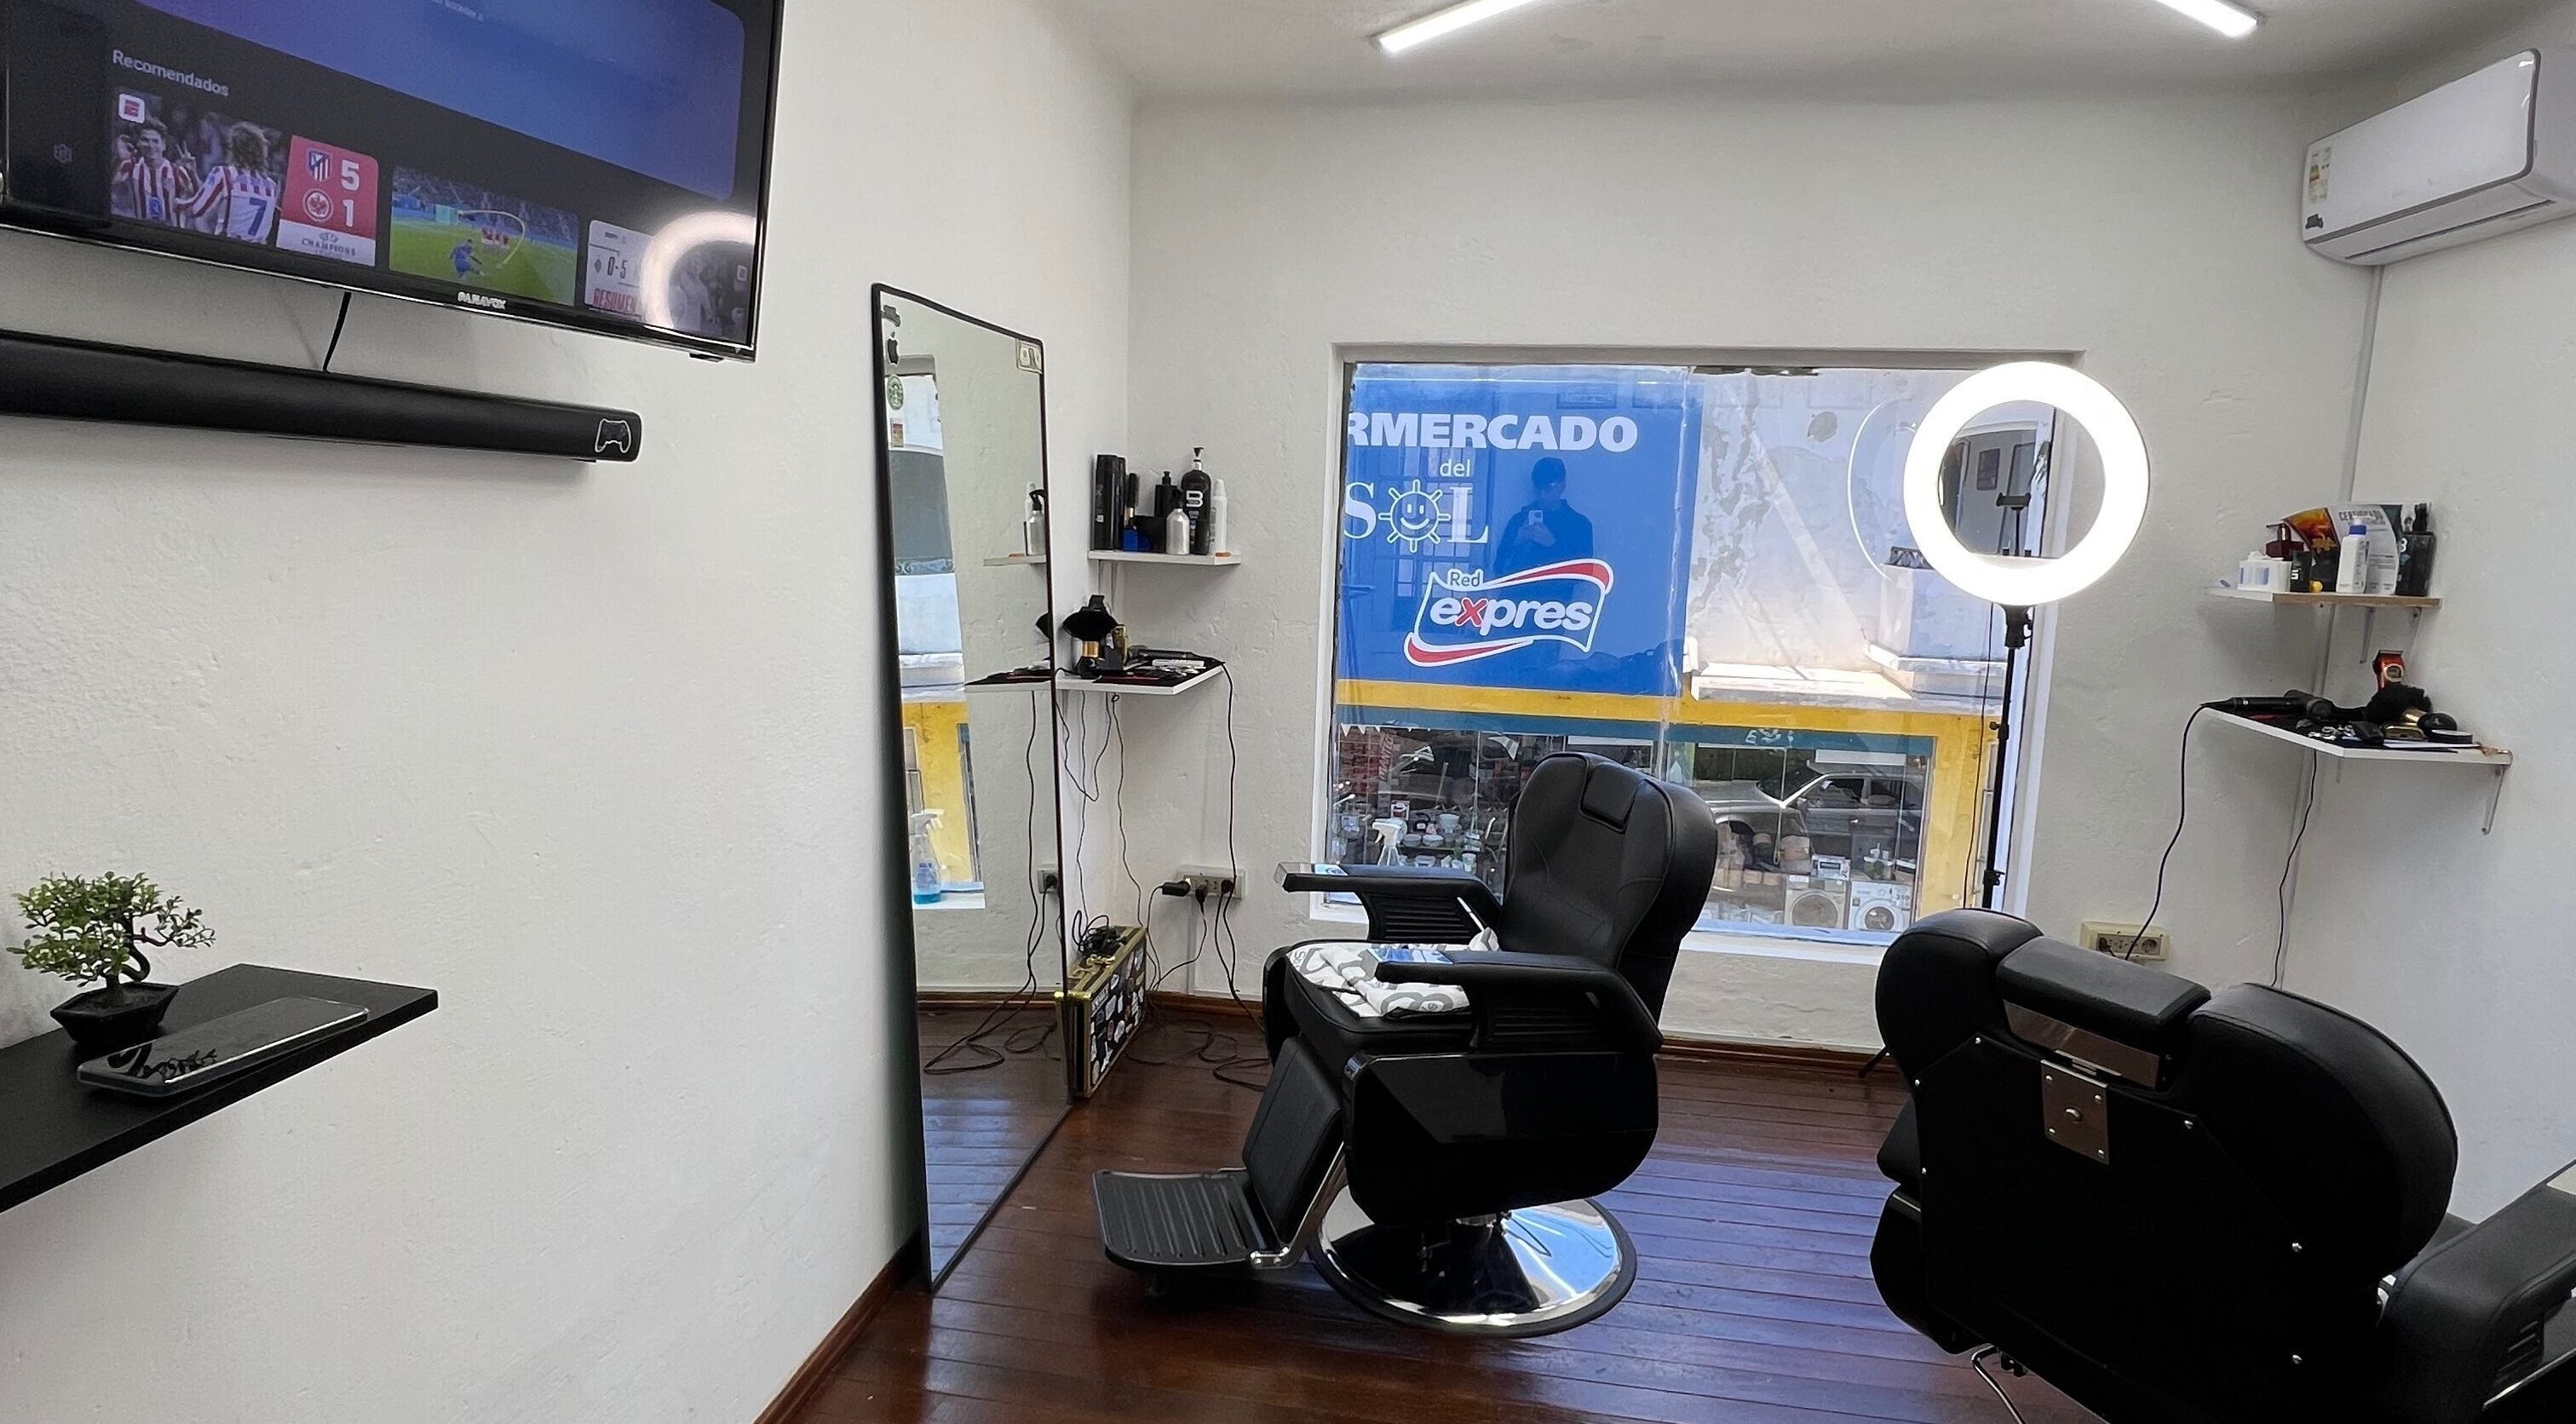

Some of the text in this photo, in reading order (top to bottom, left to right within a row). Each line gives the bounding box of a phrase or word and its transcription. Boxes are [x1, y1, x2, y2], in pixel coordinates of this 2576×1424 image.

[112, 49, 229, 96] Recomendados
[341, 159, 360, 192] 5
[249, 196, 267, 237] 7
[342, 198, 354, 227] 1
[301, 238, 357, 256] CHAMPIONS
[1439, 459, 1471, 478] del
[1450, 571, 1481, 588] Red
[1429, 597, 1594, 636] expres
